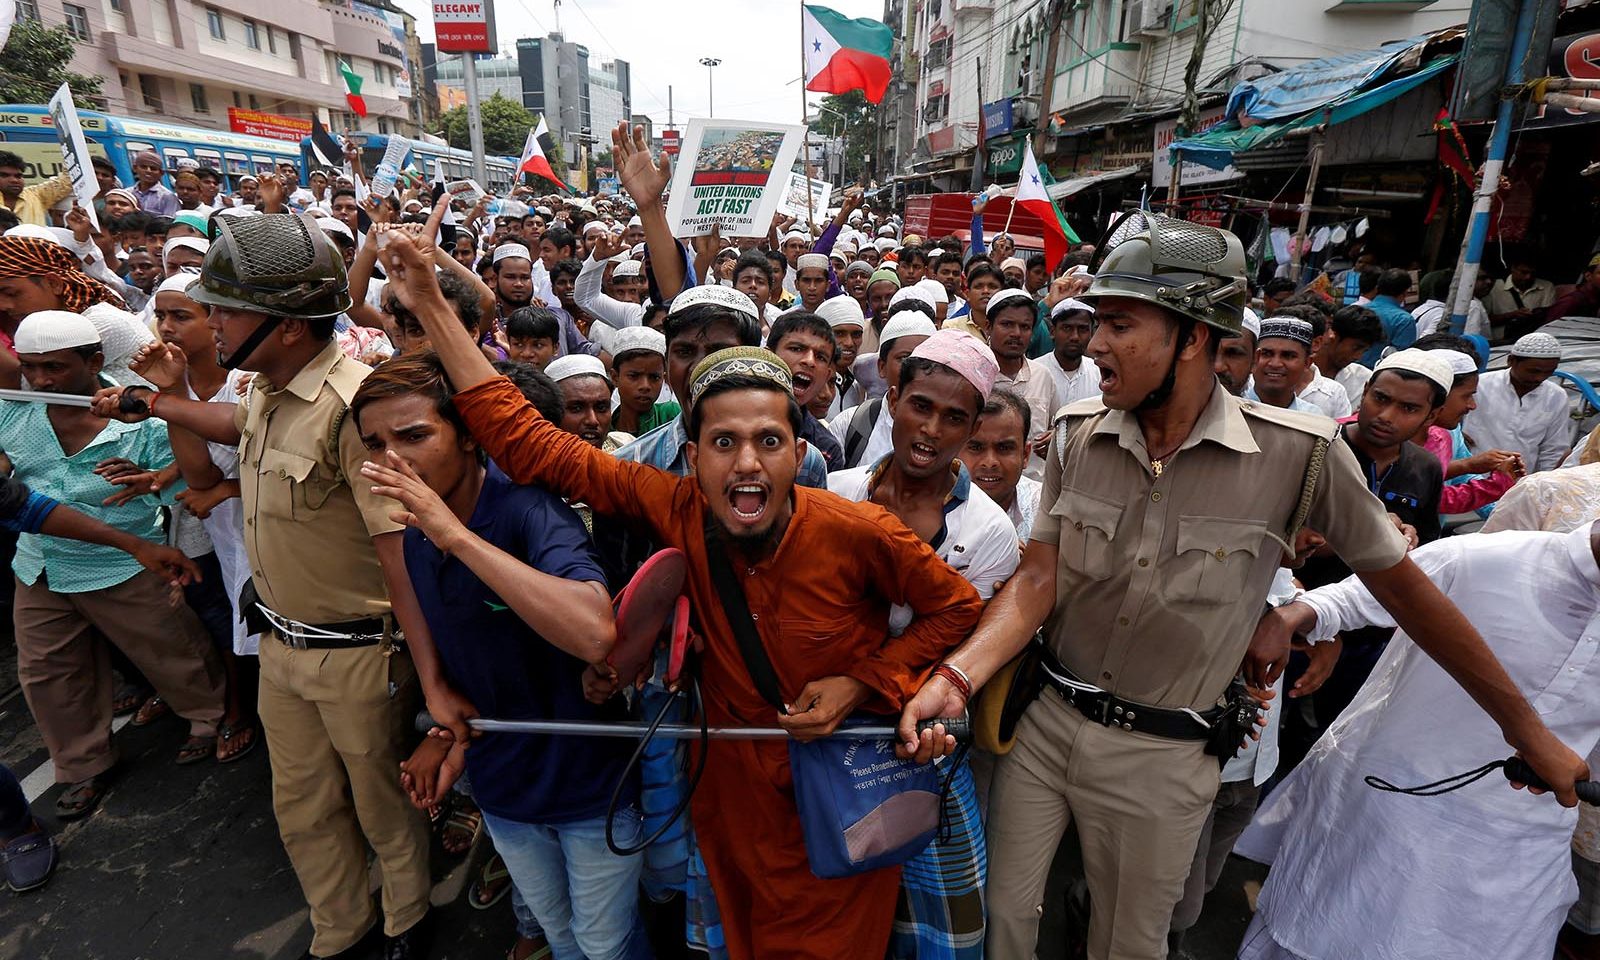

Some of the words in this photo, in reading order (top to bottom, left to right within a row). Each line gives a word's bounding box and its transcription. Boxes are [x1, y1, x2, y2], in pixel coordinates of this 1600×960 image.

[434, 4, 480, 13] ELEGANT
[694, 186, 724, 199] UNITED
[725, 187, 763, 199] NATIONS
[696, 200, 719, 215] ACT
[720, 200, 753, 215] FAST
[682, 217, 708, 226] POPULAR
[708, 216, 728, 224] FRONT
[728, 216, 736, 224] OF
[736, 216, 753, 225] INDIA
[872, 759, 899, 773] Remember
